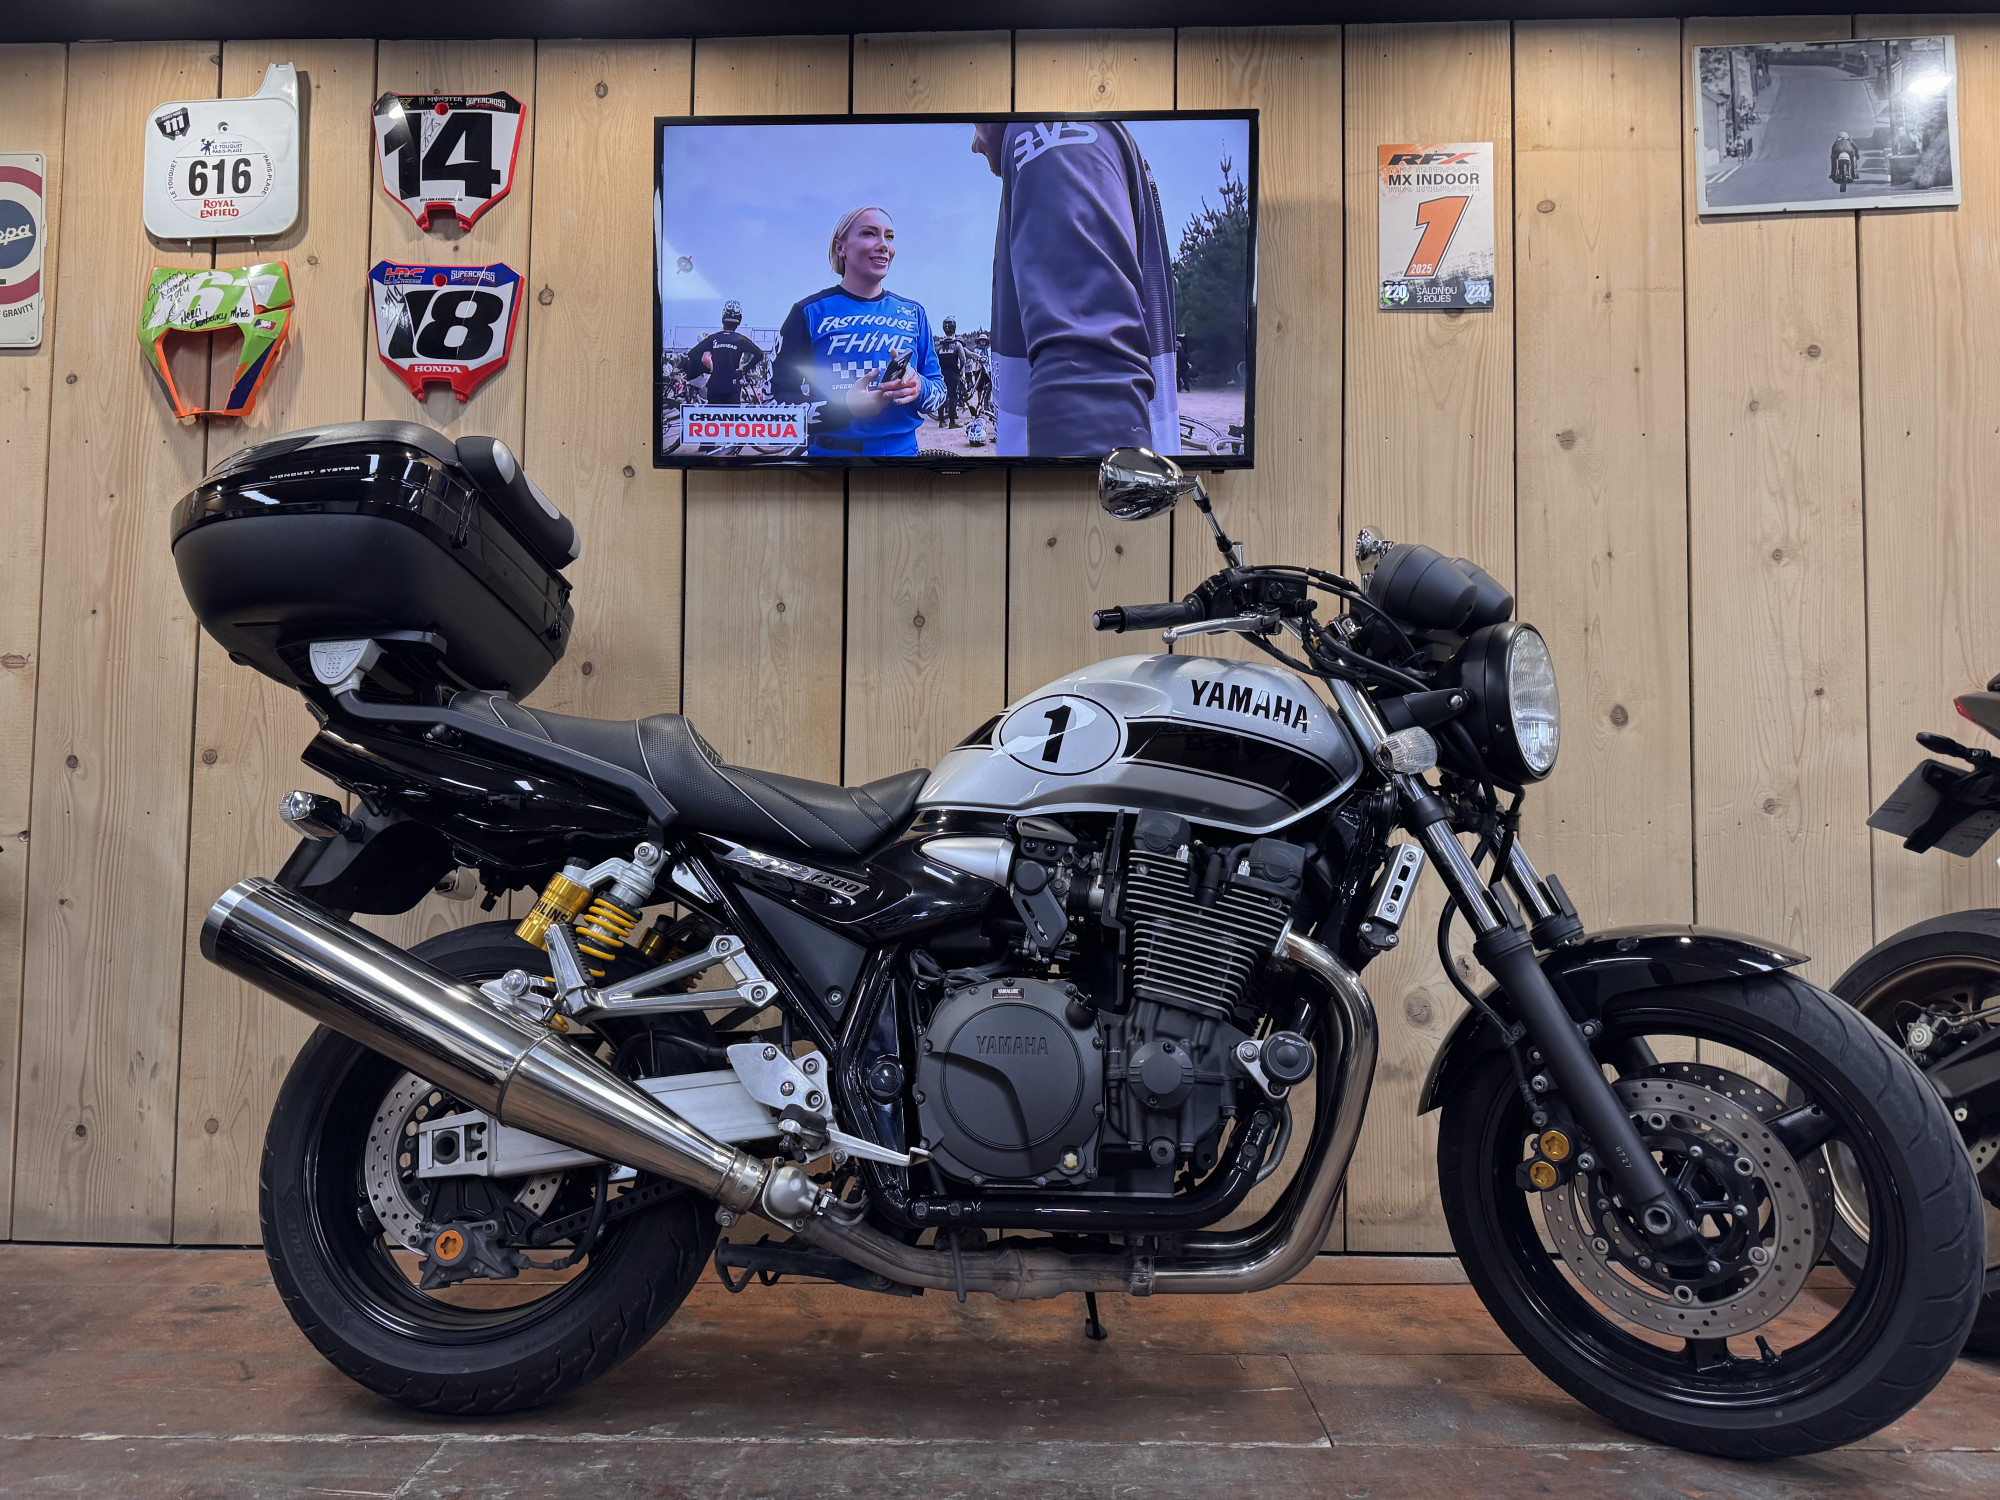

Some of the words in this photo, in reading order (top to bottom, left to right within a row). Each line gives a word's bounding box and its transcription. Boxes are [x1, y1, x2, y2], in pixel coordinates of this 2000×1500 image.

[466, 96, 506, 110] SUPERCROSS
[163, 115, 185, 134] 111
[383, 112, 501, 200] 14
[188, 157, 252, 197] 616
[1388, 174, 1412, 186] MX
[1416, 173, 1480, 186] INDOOR
[203, 199, 235, 209] ROYAL
[200, 208, 240, 219] ENFIELD
[1403, 195, 1471, 278] 1
[384, 267, 426, 282] HRC
[450, 269, 496, 283] SUPERCROSS
[1410, 263, 1433, 274] 2025
[1384, 284, 1407, 298] 220
[1416, 287, 1444, 295] SALON
[1445, 286, 1458, 295] DU
[1467, 284, 1489, 298] 220
[1416, 295, 1423, 303] 2
[1423, 294, 1452, 303] ROUES
[2, 303, 34, 318] GRAVITY
[387, 290, 504, 361] 18
[817, 314, 918, 334] FASTHOUSE
[414, 365, 463, 373] HONDA
[688, 413, 798, 422] CRANKWORX
[688, 423, 798, 438] ROTORUA
[269, 469, 315, 480] MONOKEY
[319, 465, 360, 474] SYSTEM
[1190, 678, 1310, 734] YAMAHA
[1041, 704, 1073, 764] 1
[810, 873, 861, 894] 1300
[534, 899, 569, 924] HLINS
[976, 1035, 1049, 1056] YAMAHA
[1614, 1145, 1632, 1168] 8727
[285, 1216, 327, 1296] DUNLOP
